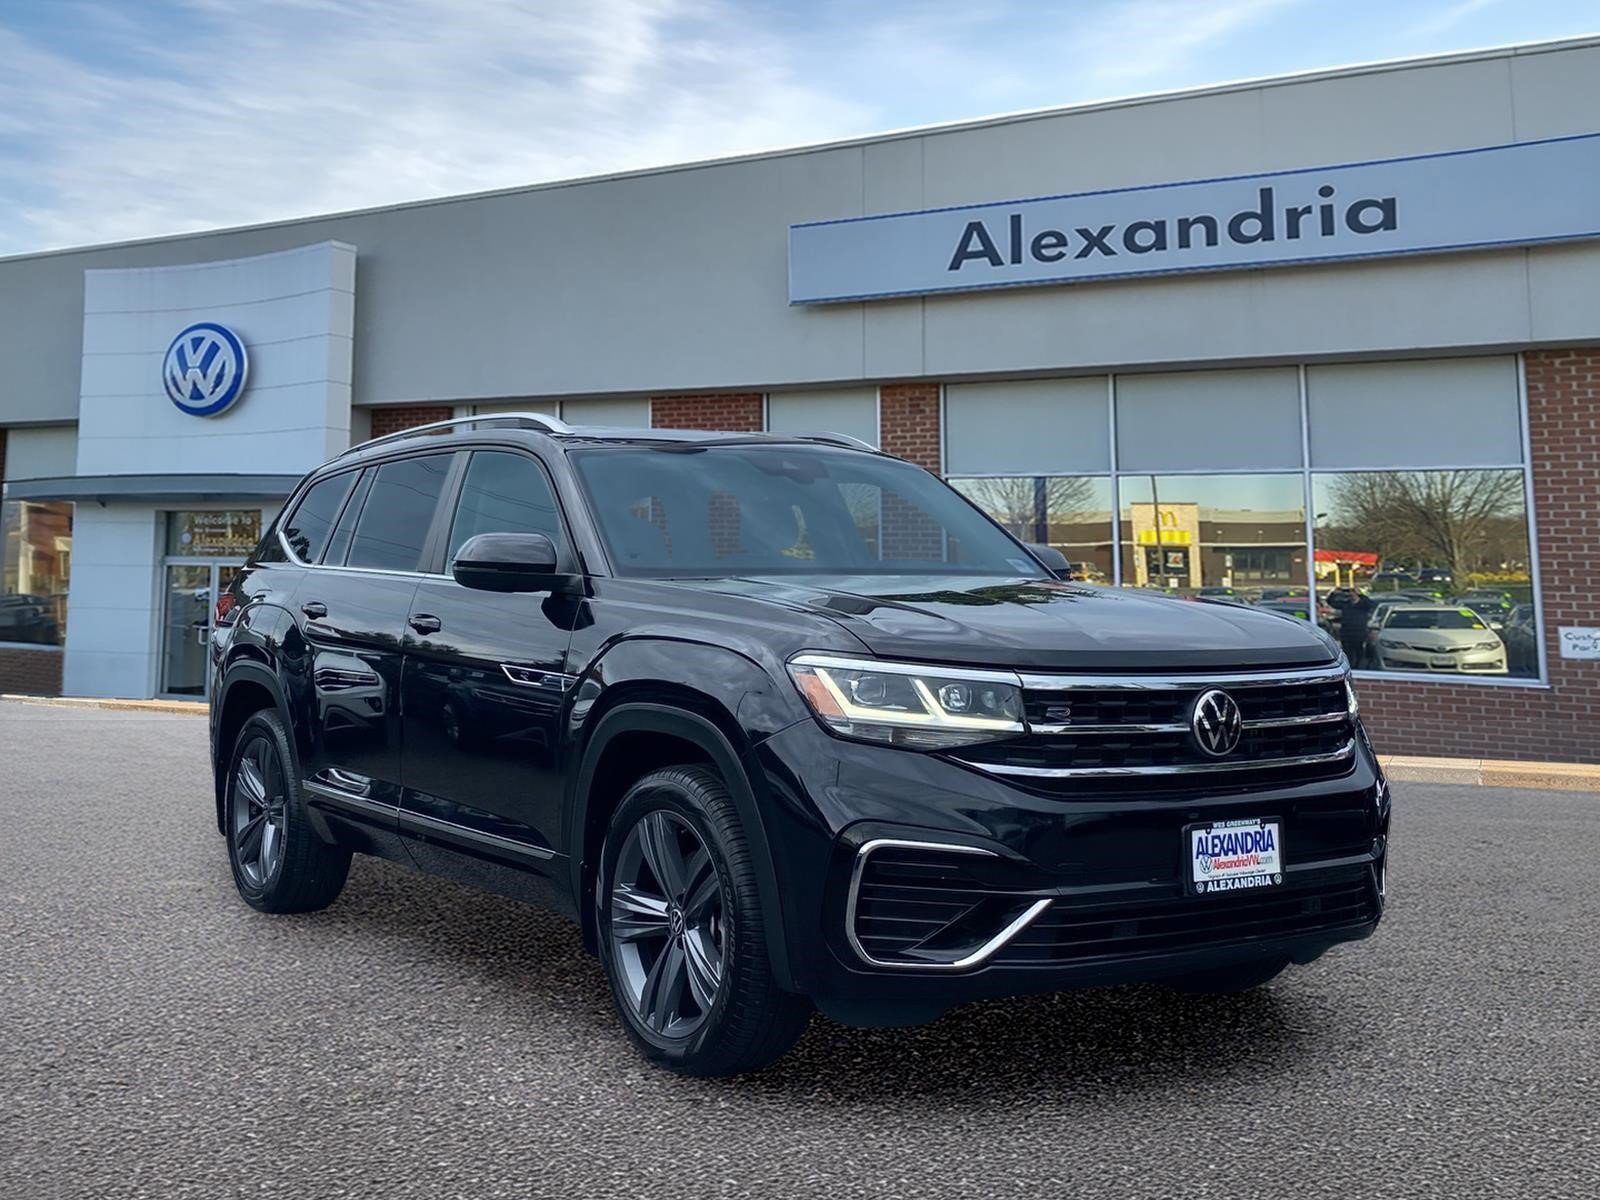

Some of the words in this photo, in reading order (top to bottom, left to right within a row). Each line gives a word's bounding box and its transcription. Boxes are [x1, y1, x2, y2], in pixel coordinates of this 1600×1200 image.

[947, 185, 1398, 271] Alexandria
[164, 326, 240, 410] VW
[1194, 690, 1241, 755] VW
[1196, 829, 1275, 860] ALEXANDRIA
[1207, 875, 1272, 892] ALEXANDRIA
